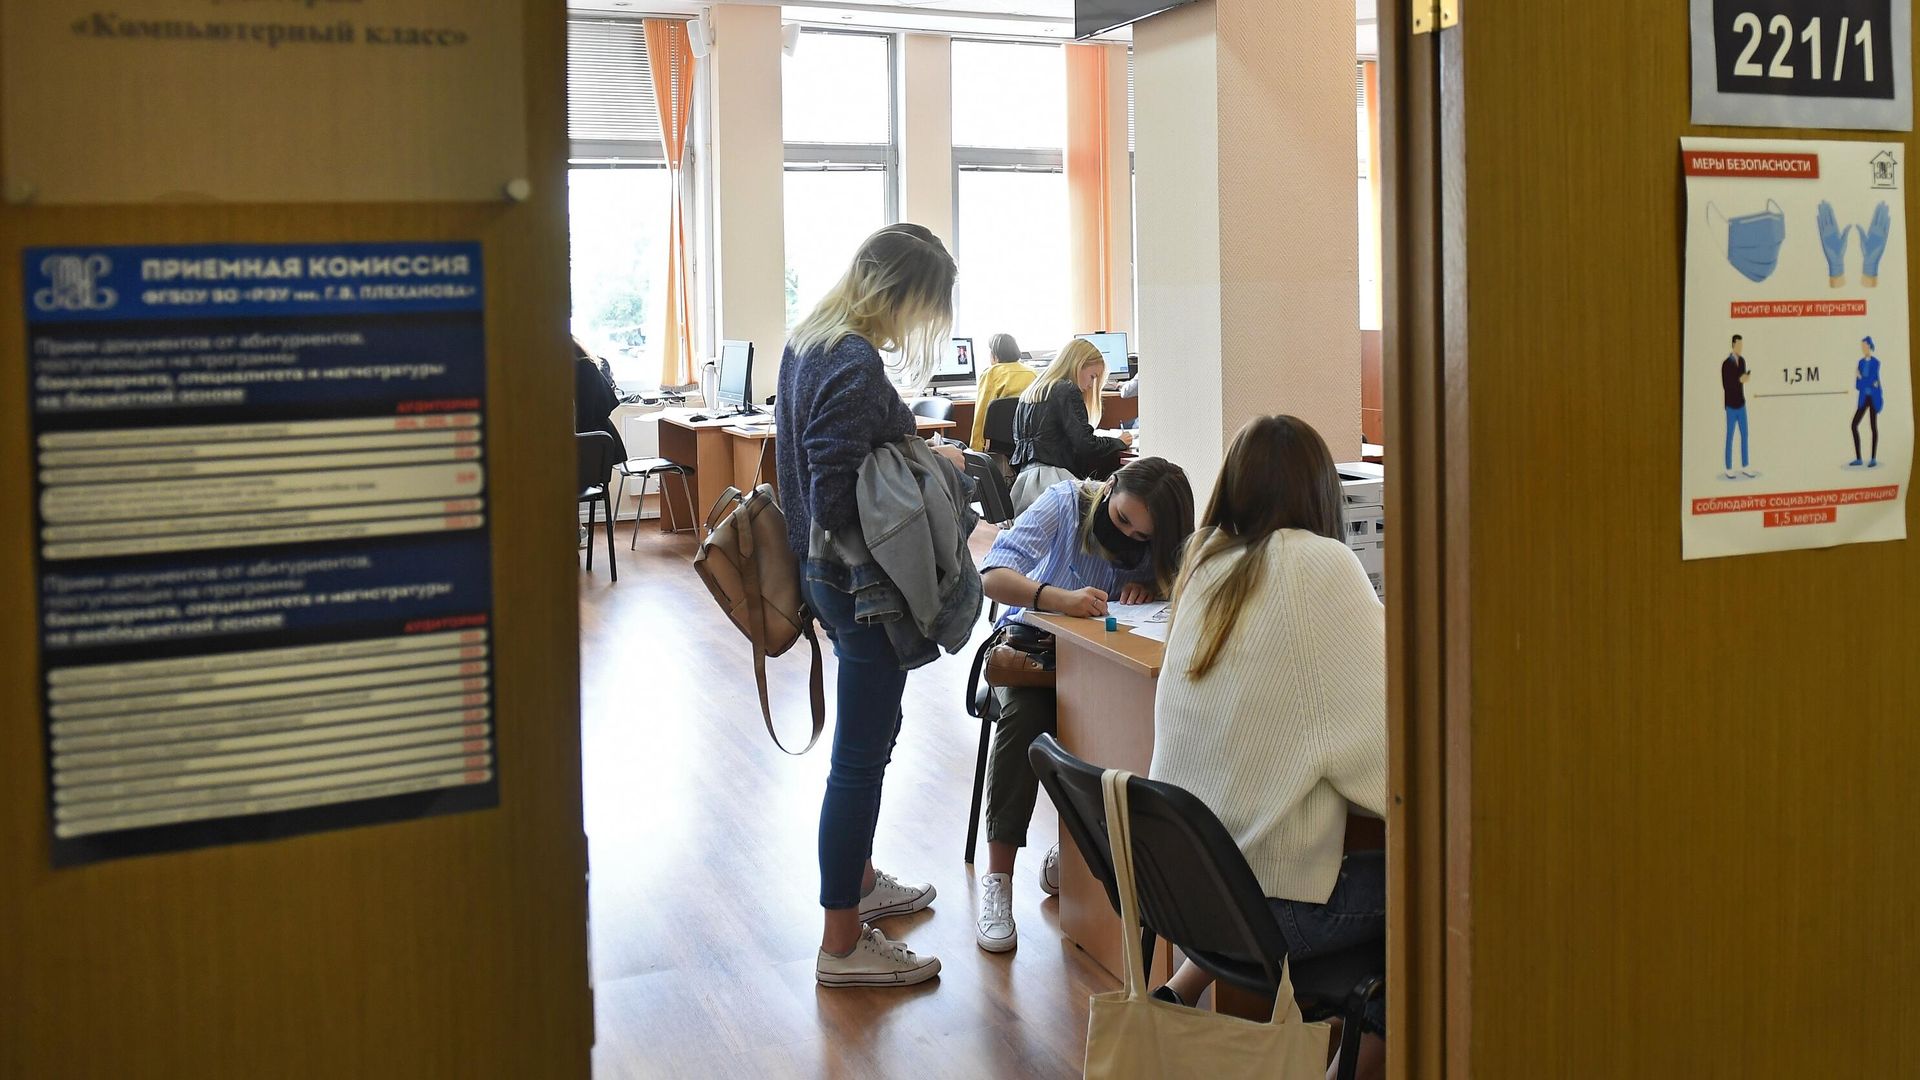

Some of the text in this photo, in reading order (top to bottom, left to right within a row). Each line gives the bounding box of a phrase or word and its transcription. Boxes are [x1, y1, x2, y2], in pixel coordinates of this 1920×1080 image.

[1732, 12, 1874, 81] 221/1
[1693, 158, 1811, 172] МЕРЫ БЕЗОПАСНОСТИ
[142, 255, 470, 281] ПРИЕМНАЯ КОМИССИЯ
[1733, 302, 1865, 317] носите маску и перчатки
[1783, 368, 1802, 385] 1,5
[1696, 488, 1897, 512] соблюдайте социальную дистанцию
[1774, 512, 1828, 527] 1,5 метра
